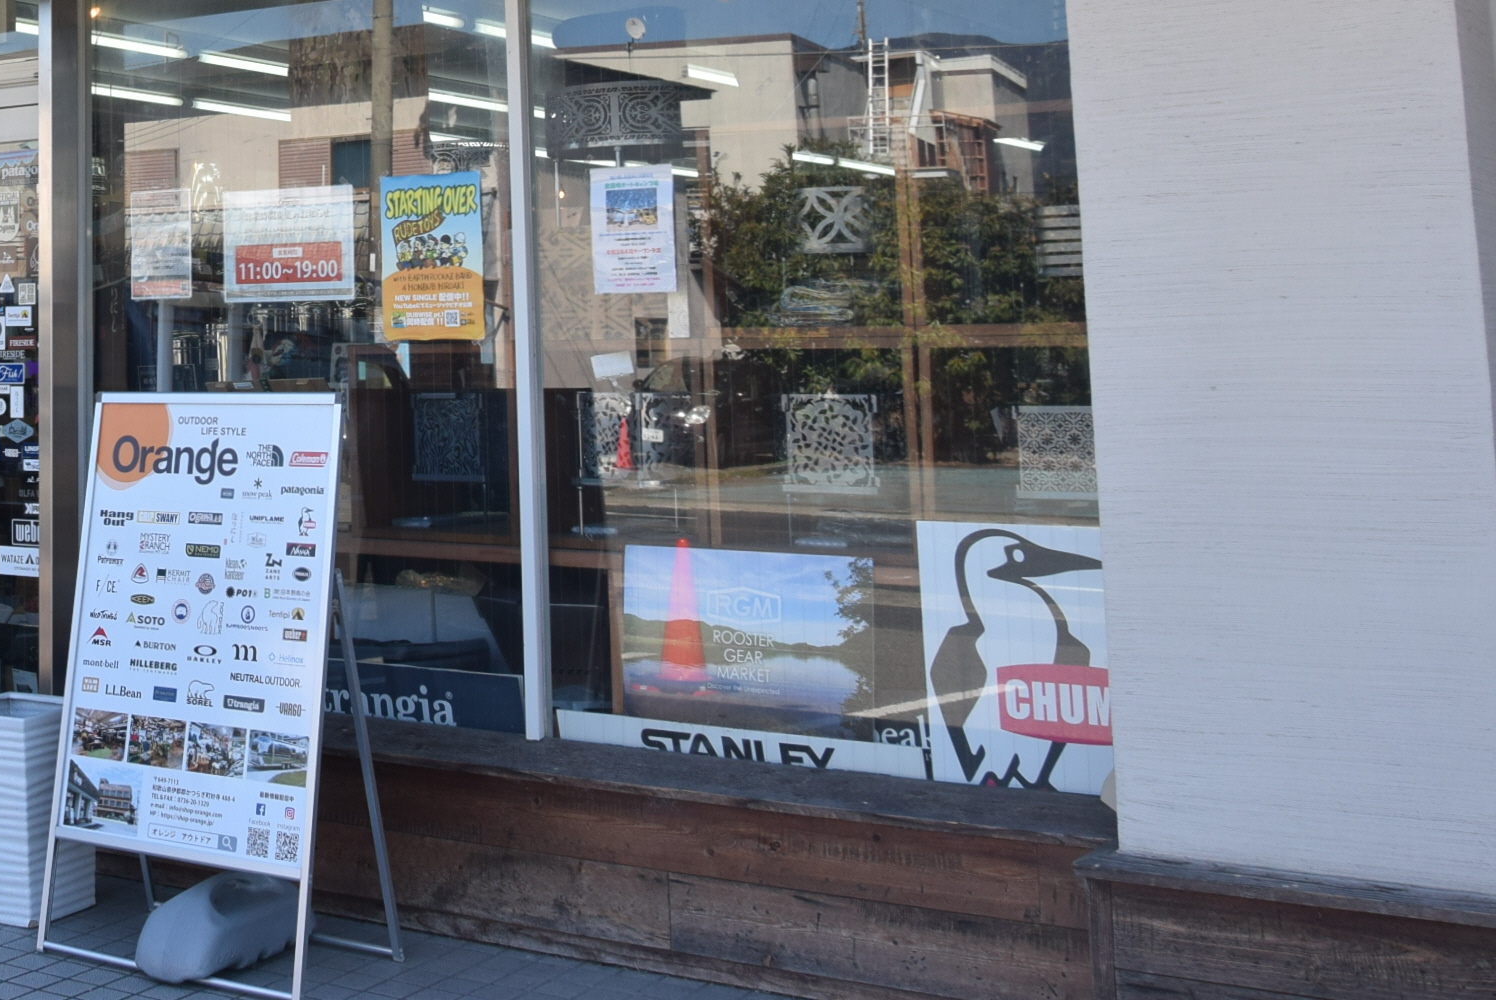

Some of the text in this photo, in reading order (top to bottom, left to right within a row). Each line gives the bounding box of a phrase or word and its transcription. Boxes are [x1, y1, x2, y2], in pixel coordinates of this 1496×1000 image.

[385, 183, 478, 219] STARTING OVER
[395, 294, 411, 302] NEW
[9, 339, 35, 347] FIRESIDE
[178, 416, 219, 425] OUTDOOR
[201, 427, 247, 436] LIFE STYLE
[112, 435, 238, 485] Orange
[246, 451, 272, 459] NORTH
[252, 459, 271, 467] FACE
[258, 489, 272, 499] peak
[280, 486, 324, 496] patagonia
[100, 509, 134, 521] Hang
[155, 512, 178, 523] SWANY
[103, 517, 126, 526] Out
[140, 533, 171, 542] MYSTERY
[145, 542, 170, 551] RANCH
[194, 545, 219, 553] NEMO
[1, 554, 24, 565] WATAZE
[132, 595, 154, 603] KEEN
[715, 593, 773, 618] RGM
[269, 610, 290, 619] Tentipi
[137, 615, 165, 626] SOTO
[713, 630, 775, 648] ROOSTER
[143, 641, 176, 651] BURTON
[187, 656, 222, 664] OAKLEY
[279, 654, 304, 664] Helinox
[724, 648, 763, 664] GEAR
[130, 658, 177, 671] HILLEBERG
[717, 666, 771, 683] MARKET
[230, 672, 301, 688] NEUTRAL OUTDOOR
[707, 682, 731, 690] Discover
[186, 698, 213, 708] SOREL
[279, 702, 302, 717] VARGO
[248, 817, 271, 828] Facebook
[152, 828, 212, 845] オレンジ アウトドア
